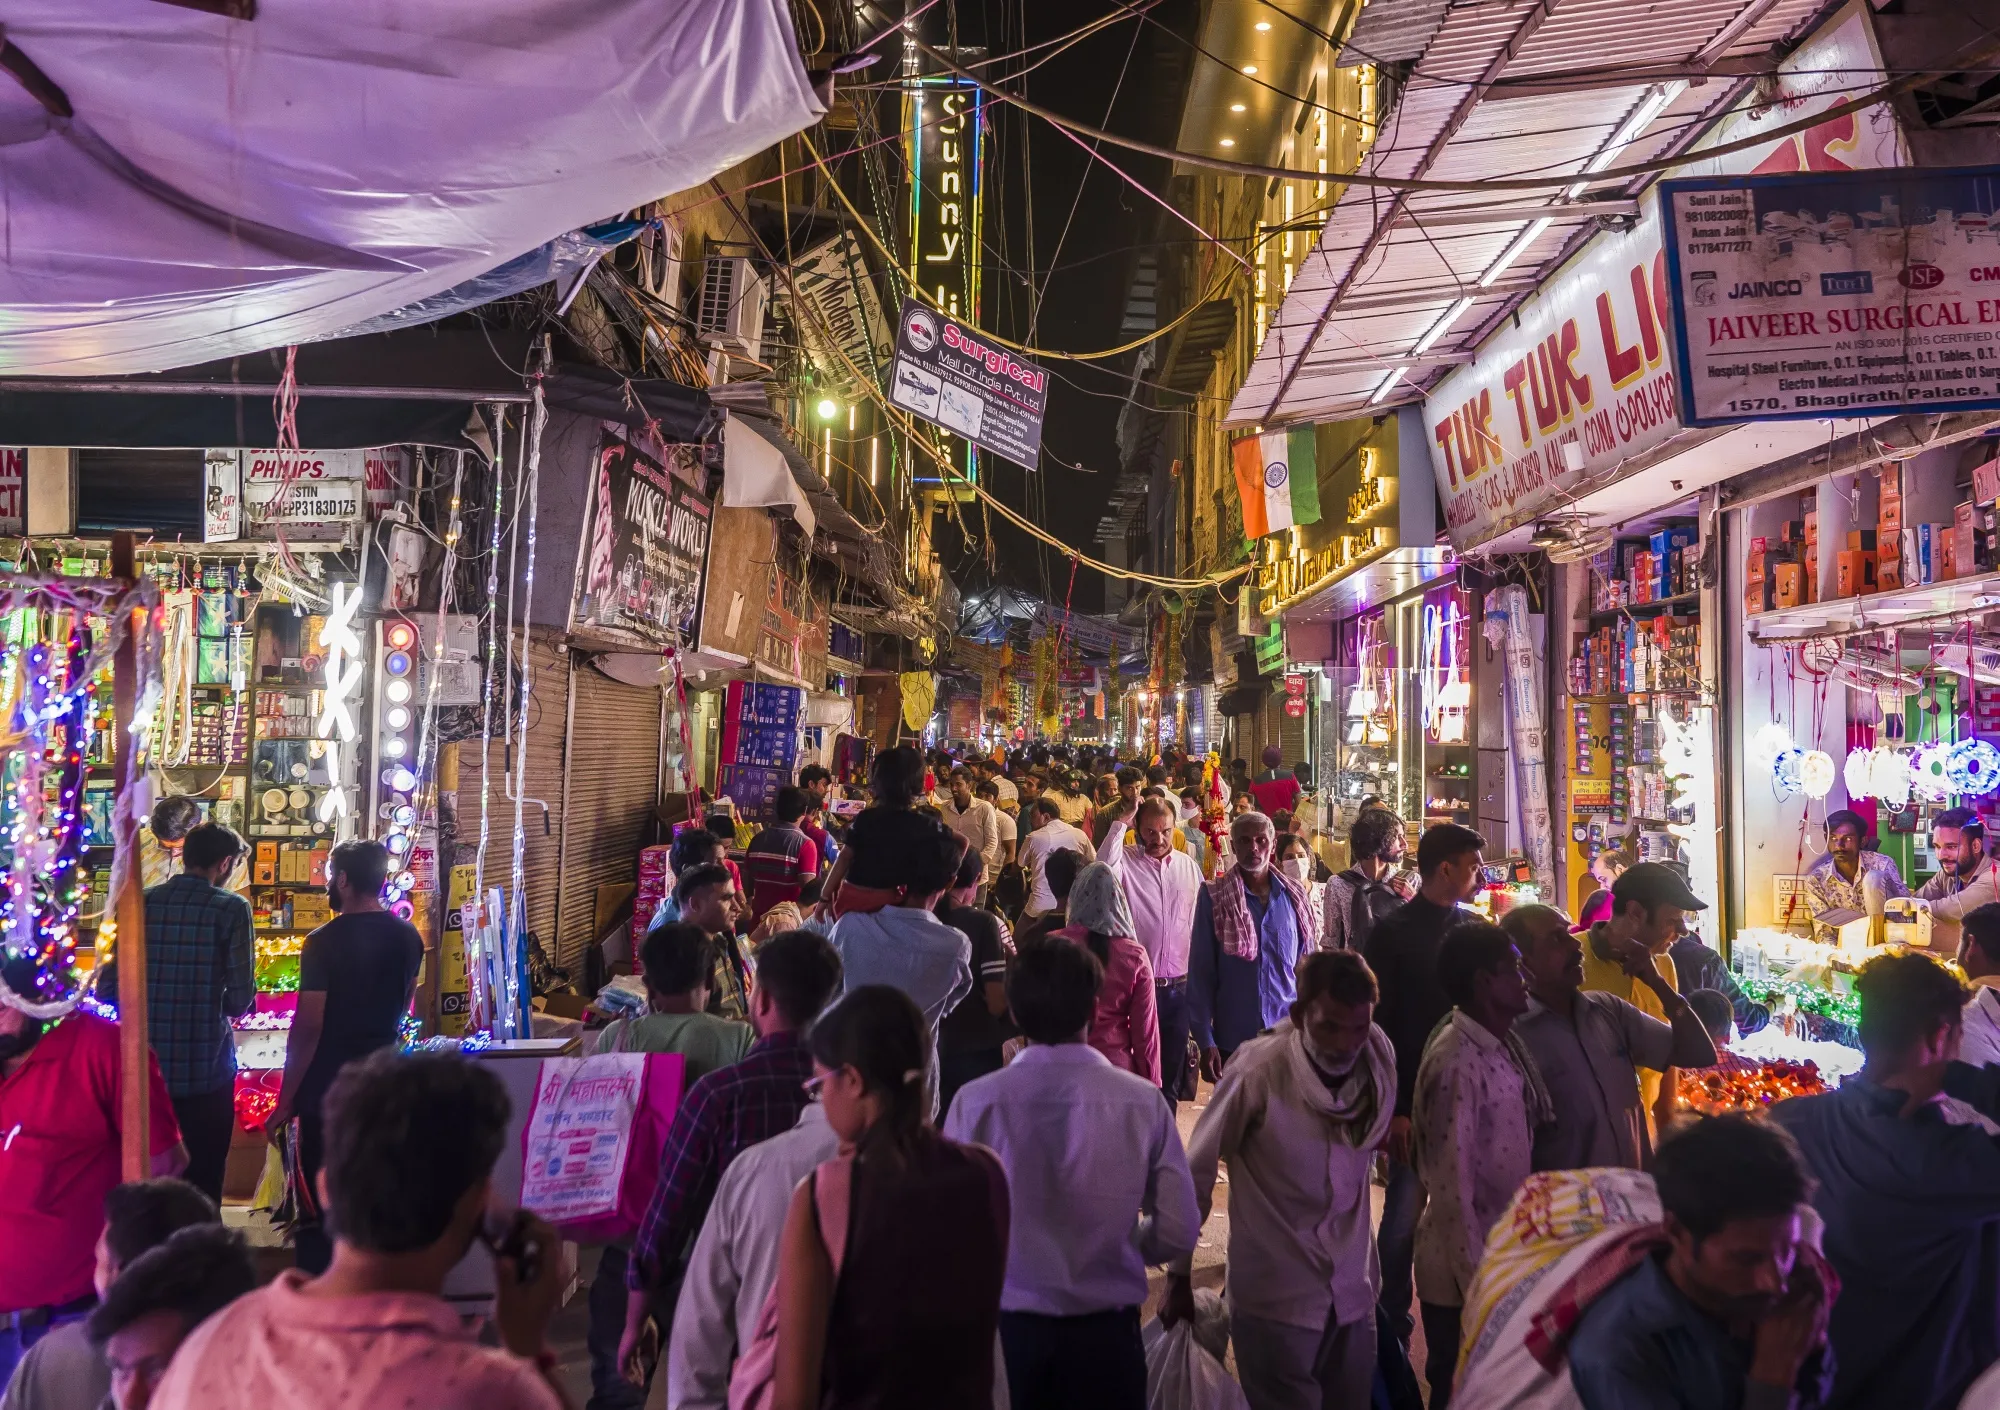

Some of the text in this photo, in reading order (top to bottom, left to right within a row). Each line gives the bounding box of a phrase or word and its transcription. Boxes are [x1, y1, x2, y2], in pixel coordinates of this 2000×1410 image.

[1689, 194, 1741, 206] Sunil Jain
[1692, 226, 1746, 238] Aman Jain
[1727, 280, 1802, 299] JAINCO
[1707, 312, 1820, 347] JAIVEER
[1827, 301, 1970, 333] SURGICAL
[1835, 341, 1851, 350] AN
[1854, 339, 1874, 349] ISO
[1933, 332, 1992, 343] CERTIFIED
[899, 349, 913, 362] Phone
[943, 323, 1044, 393] Surgical
[1707, 363, 1749, 379] Hospital
[1752, 362, 1778, 374] Steel
[1781, 360, 1832, 373] Furniture,
[1916, 351, 1936, 364] O.T.
[1939, 349, 1975, 363] Tables,
[938, 350, 961, 369] Mall
[963, 363, 977, 377] Of
[979, 371, 1001, 391] India
[1779, 378, 1815, 391] Electro
[1818, 374, 1858, 389] Medical
[1861, 372, 1905, 385] Products
[1919, 369, 1933, 381] All
[1935, 367, 1963, 380] Kinds
[1965, 366, 1977, 378] Of
[1434, 388, 1502, 491] TUK
[1504, 317, 1593, 448] TUK
[1727, 386, 1989, 412] 1570, Bhagirath Palace,
[1584, 408, 1617, 457] CONA
[625, 476, 672, 541] MUSCLE
